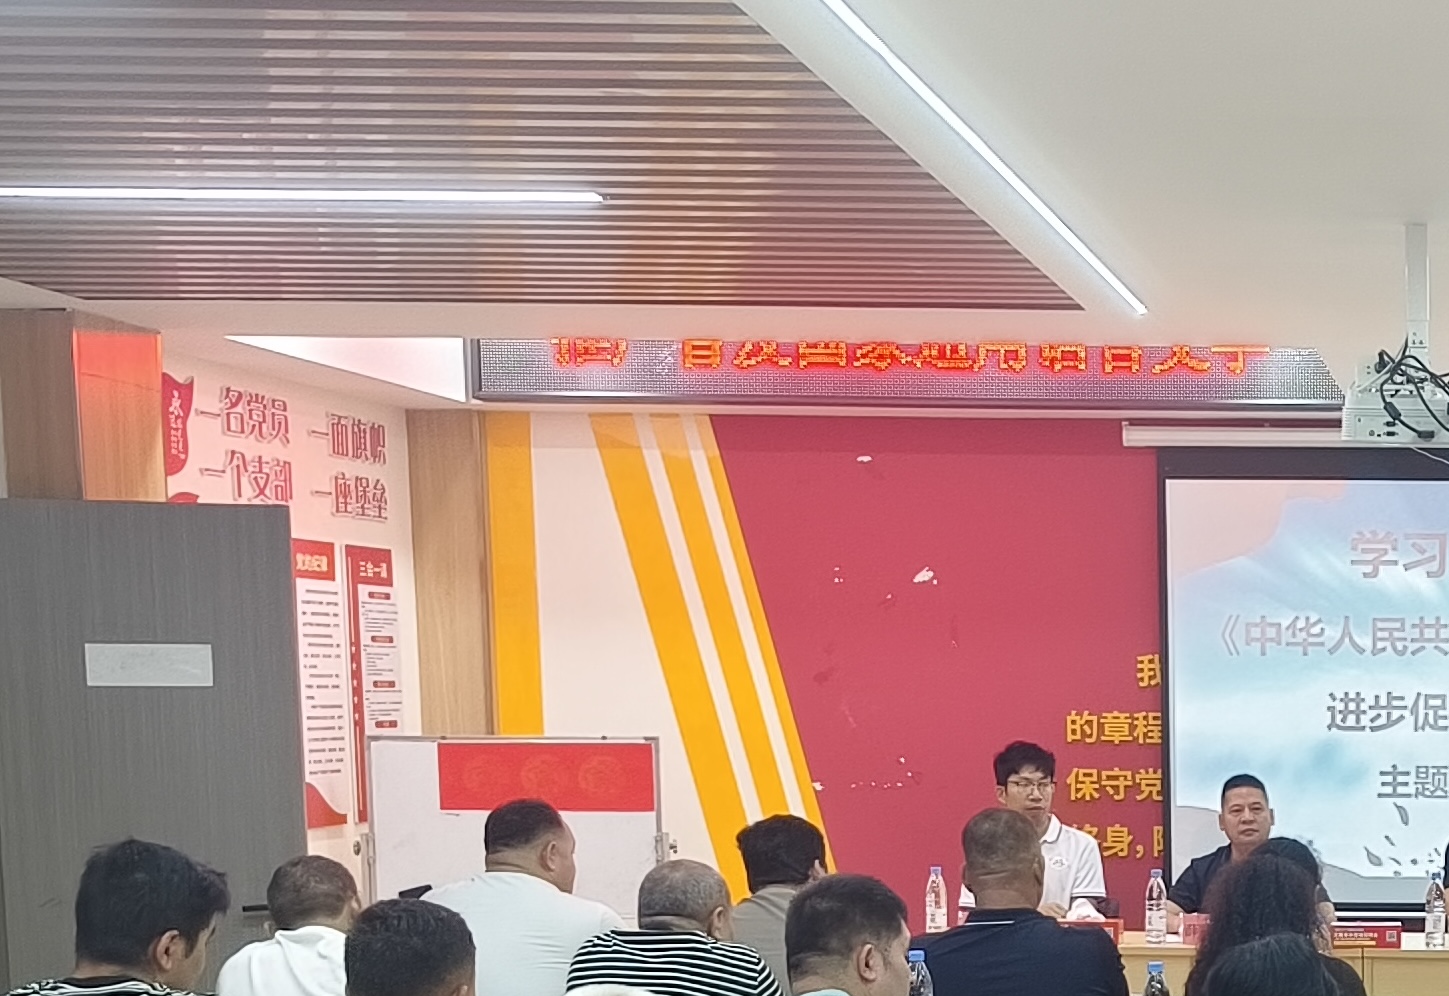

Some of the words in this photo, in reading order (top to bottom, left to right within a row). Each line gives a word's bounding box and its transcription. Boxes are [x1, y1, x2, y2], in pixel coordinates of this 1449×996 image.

[197, 386, 290, 445] 一名党员
[309, 413, 387, 465] 一面旗帜
[202, 449, 293, 503] 一个支部
[313, 472, 388, 520] 一座堡垒
[1136, 653, 1162, 688] 我
[1066, 710, 1163, 745] 的章程
[1066, 767, 1164, 802] 保守党
